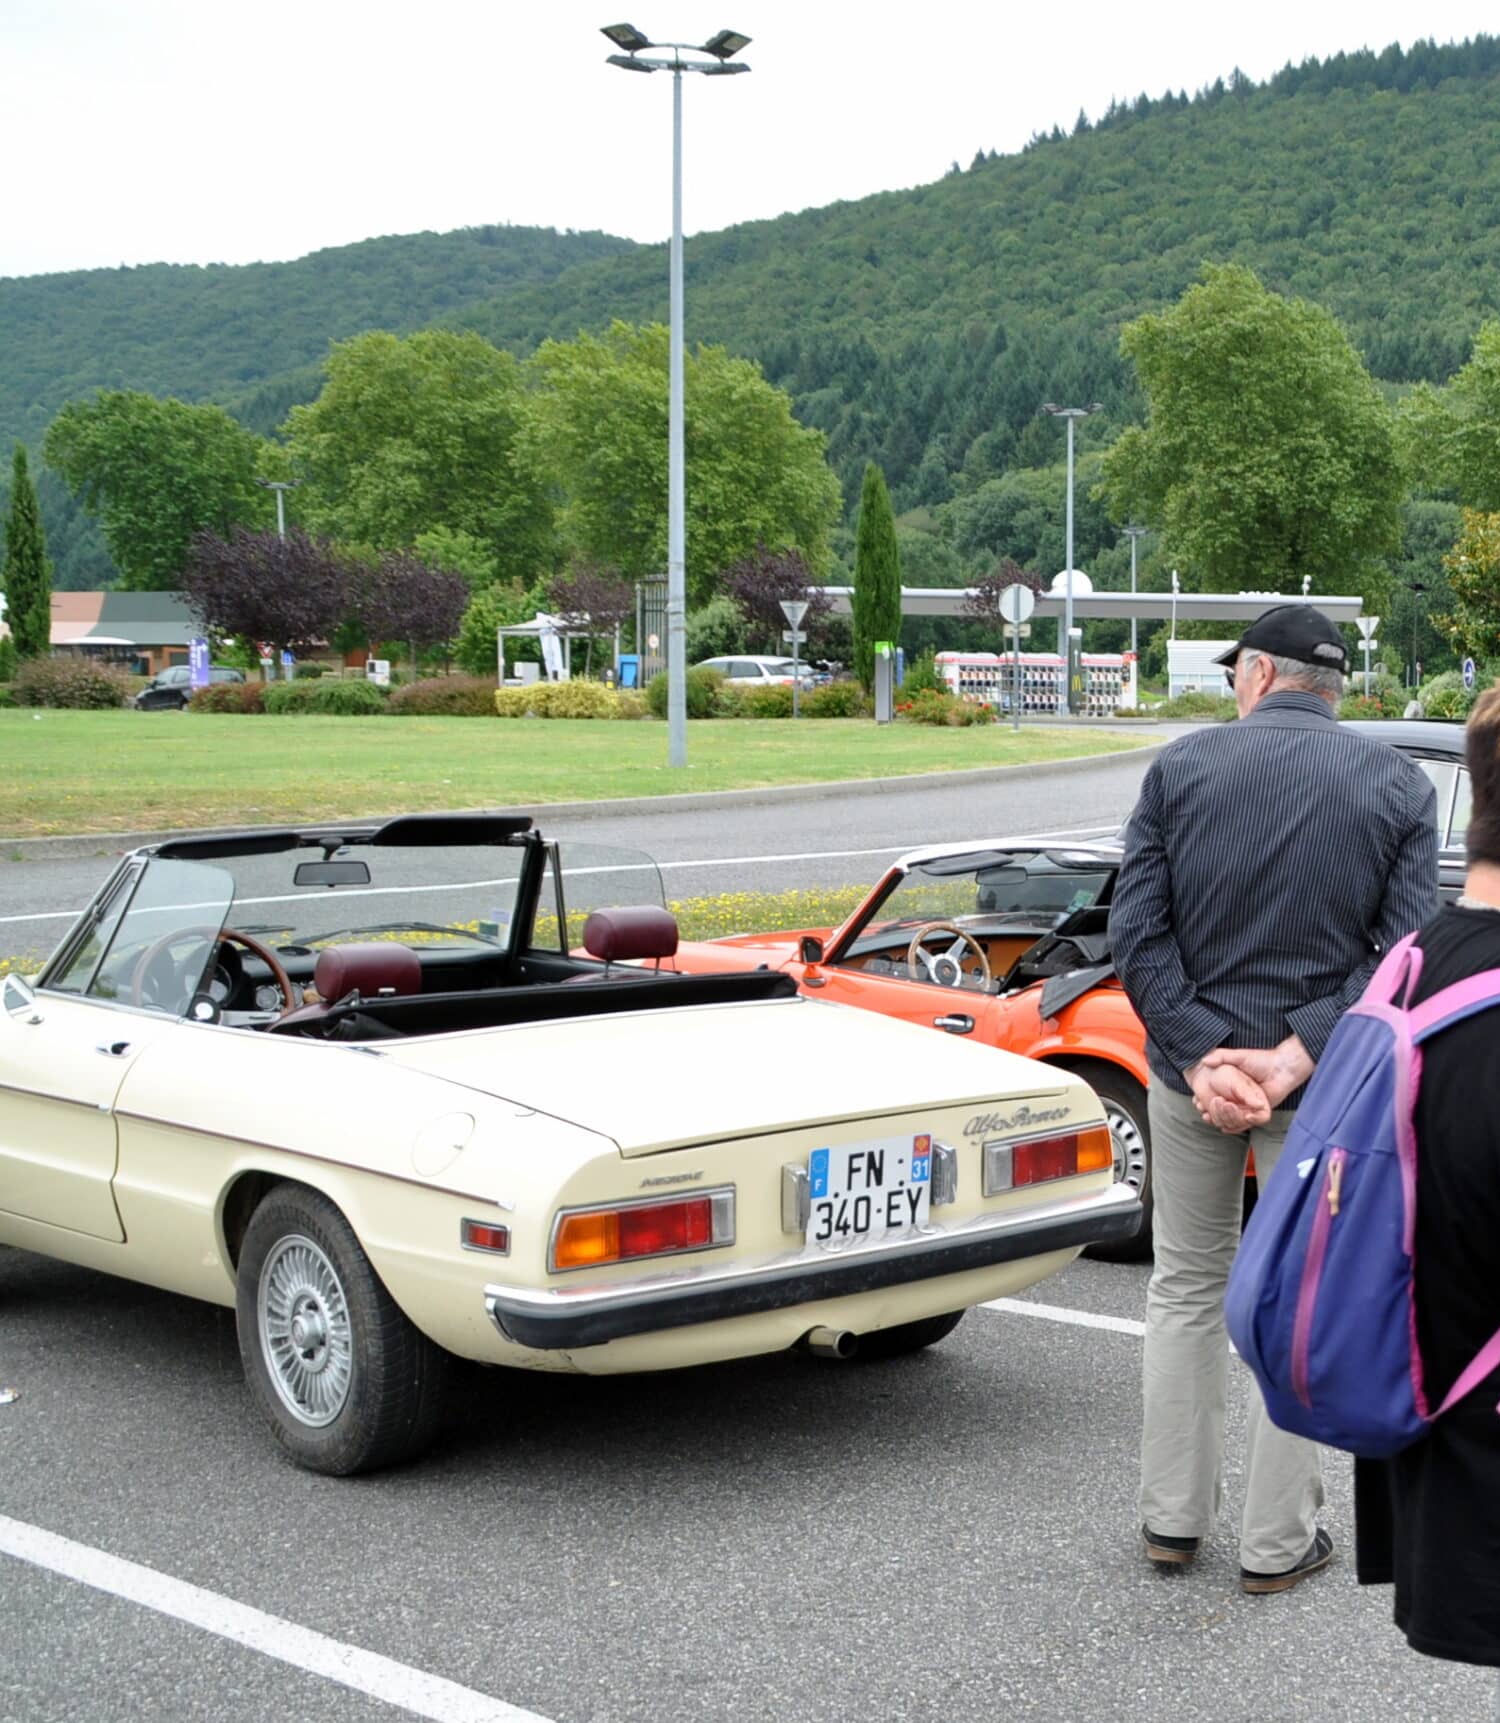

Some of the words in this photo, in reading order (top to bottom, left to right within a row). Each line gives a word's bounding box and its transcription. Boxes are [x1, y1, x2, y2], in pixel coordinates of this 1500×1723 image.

[847, 1149, 884, 1191] FN
[912, 1159, 929, 1179] 31
[814, 1178, 823, 1192] F
